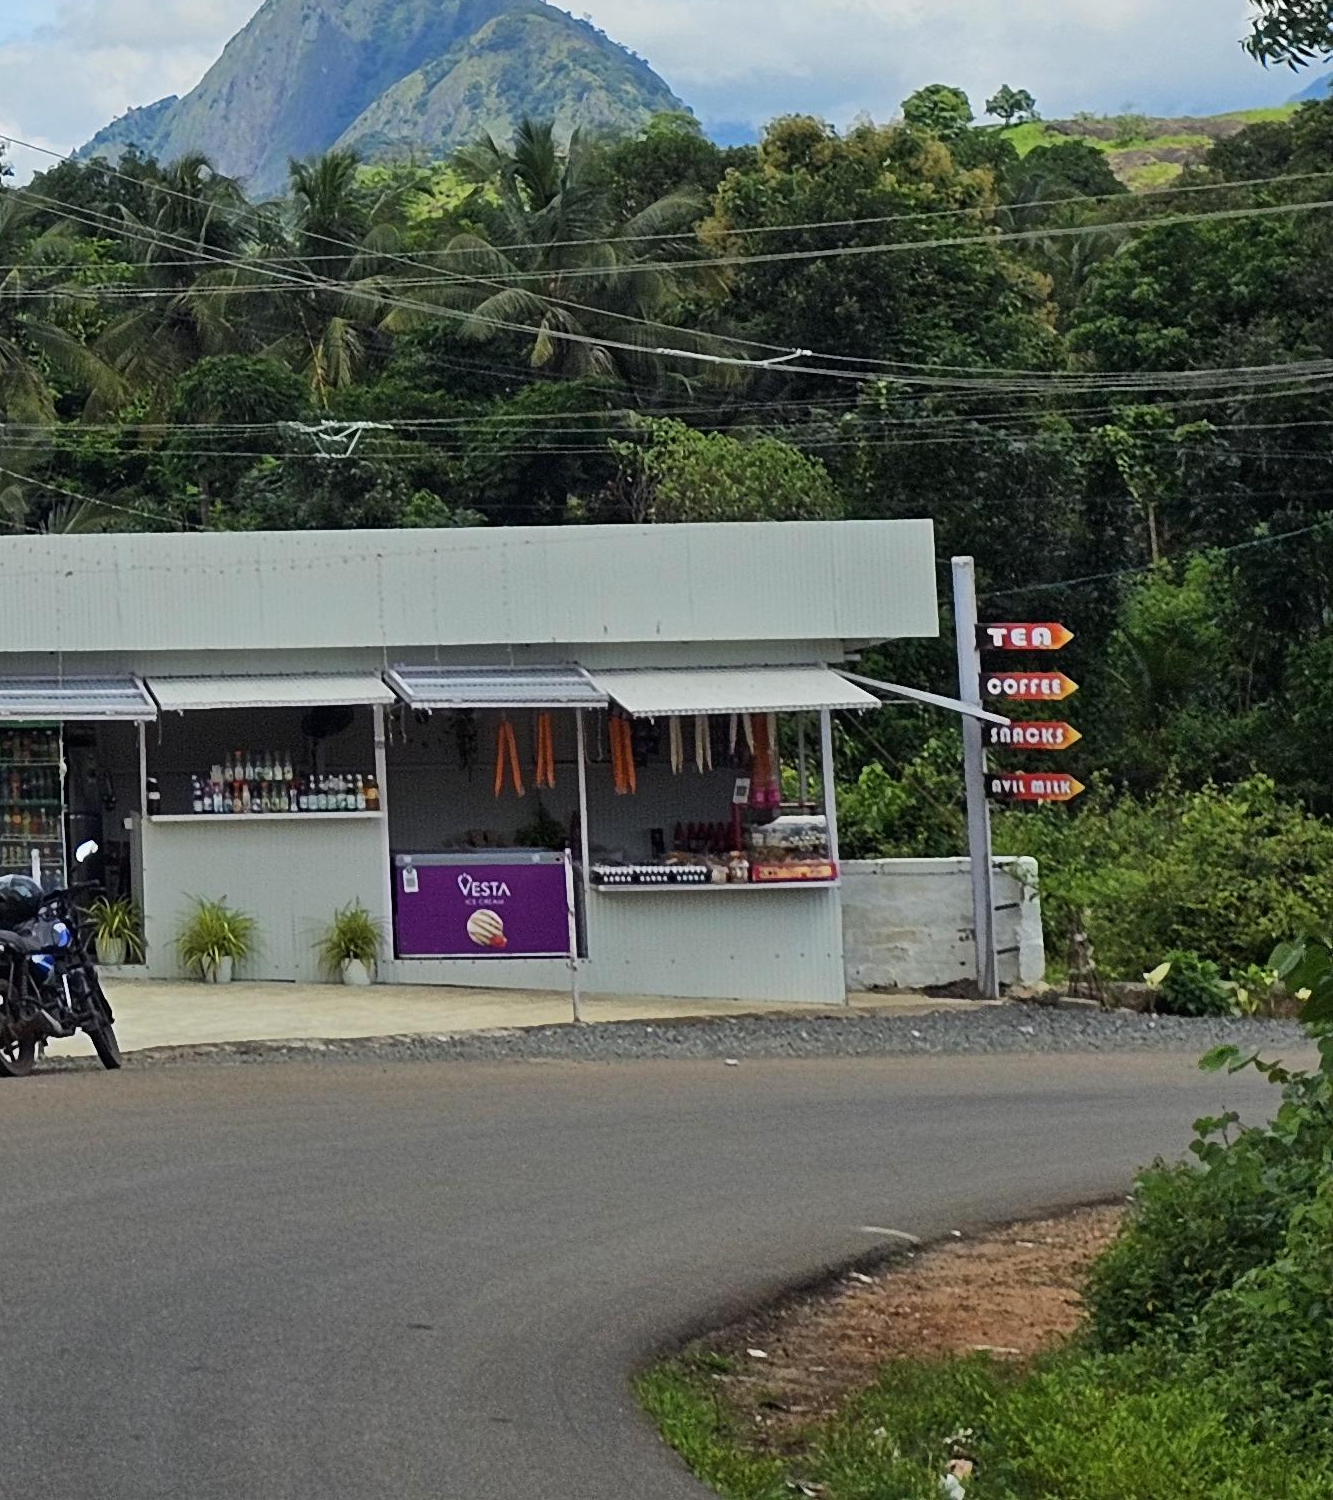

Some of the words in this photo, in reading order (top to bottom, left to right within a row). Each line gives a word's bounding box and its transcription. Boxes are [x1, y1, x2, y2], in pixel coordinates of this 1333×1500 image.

[986, 627, 1052, 647] TEA
[986, 678, 1061, 695] COFFEE
[990, 727, 1064, 744] SNACKS
[991, 779, 1025, 794] AVIL
[1030, 780, 1071, 794] MILK
[457, 872, 511, 897] VESTA
